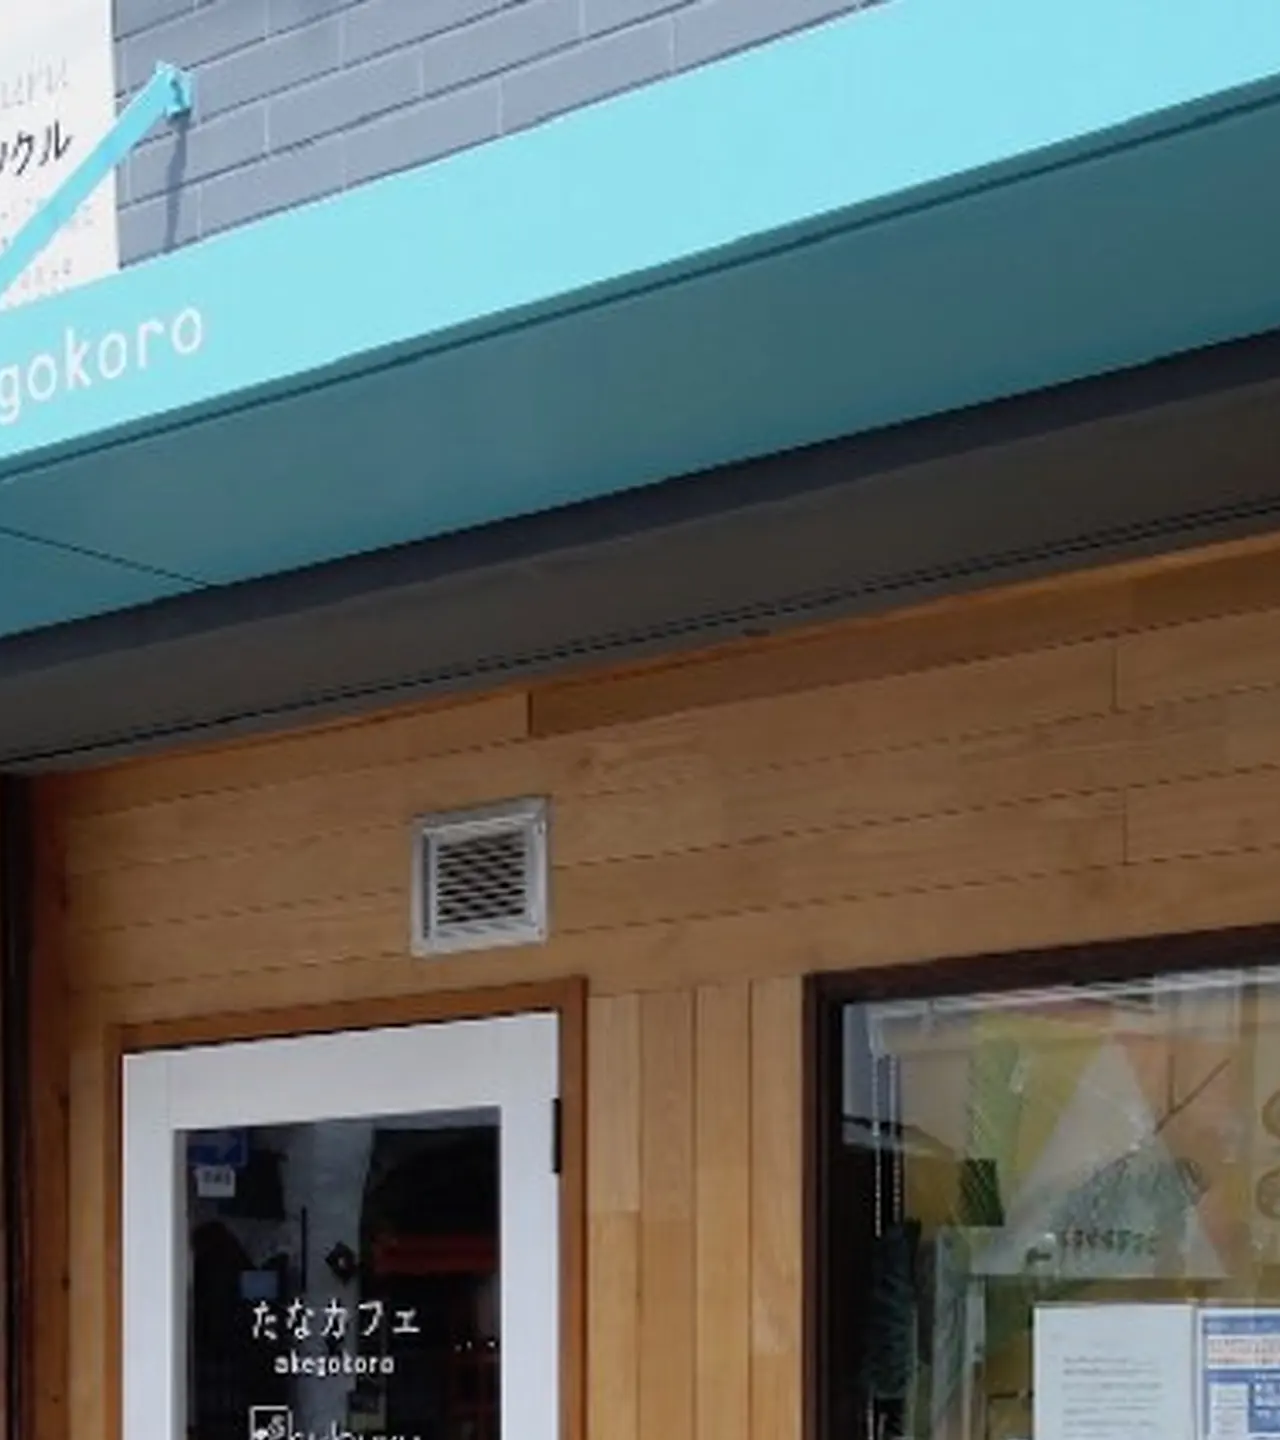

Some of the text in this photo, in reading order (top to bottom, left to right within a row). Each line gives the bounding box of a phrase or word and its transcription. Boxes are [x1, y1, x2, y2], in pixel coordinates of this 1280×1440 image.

[252, 1297, 421, 1340] たなカフェ
[274, 1349, 395, 1378] akegokoro
